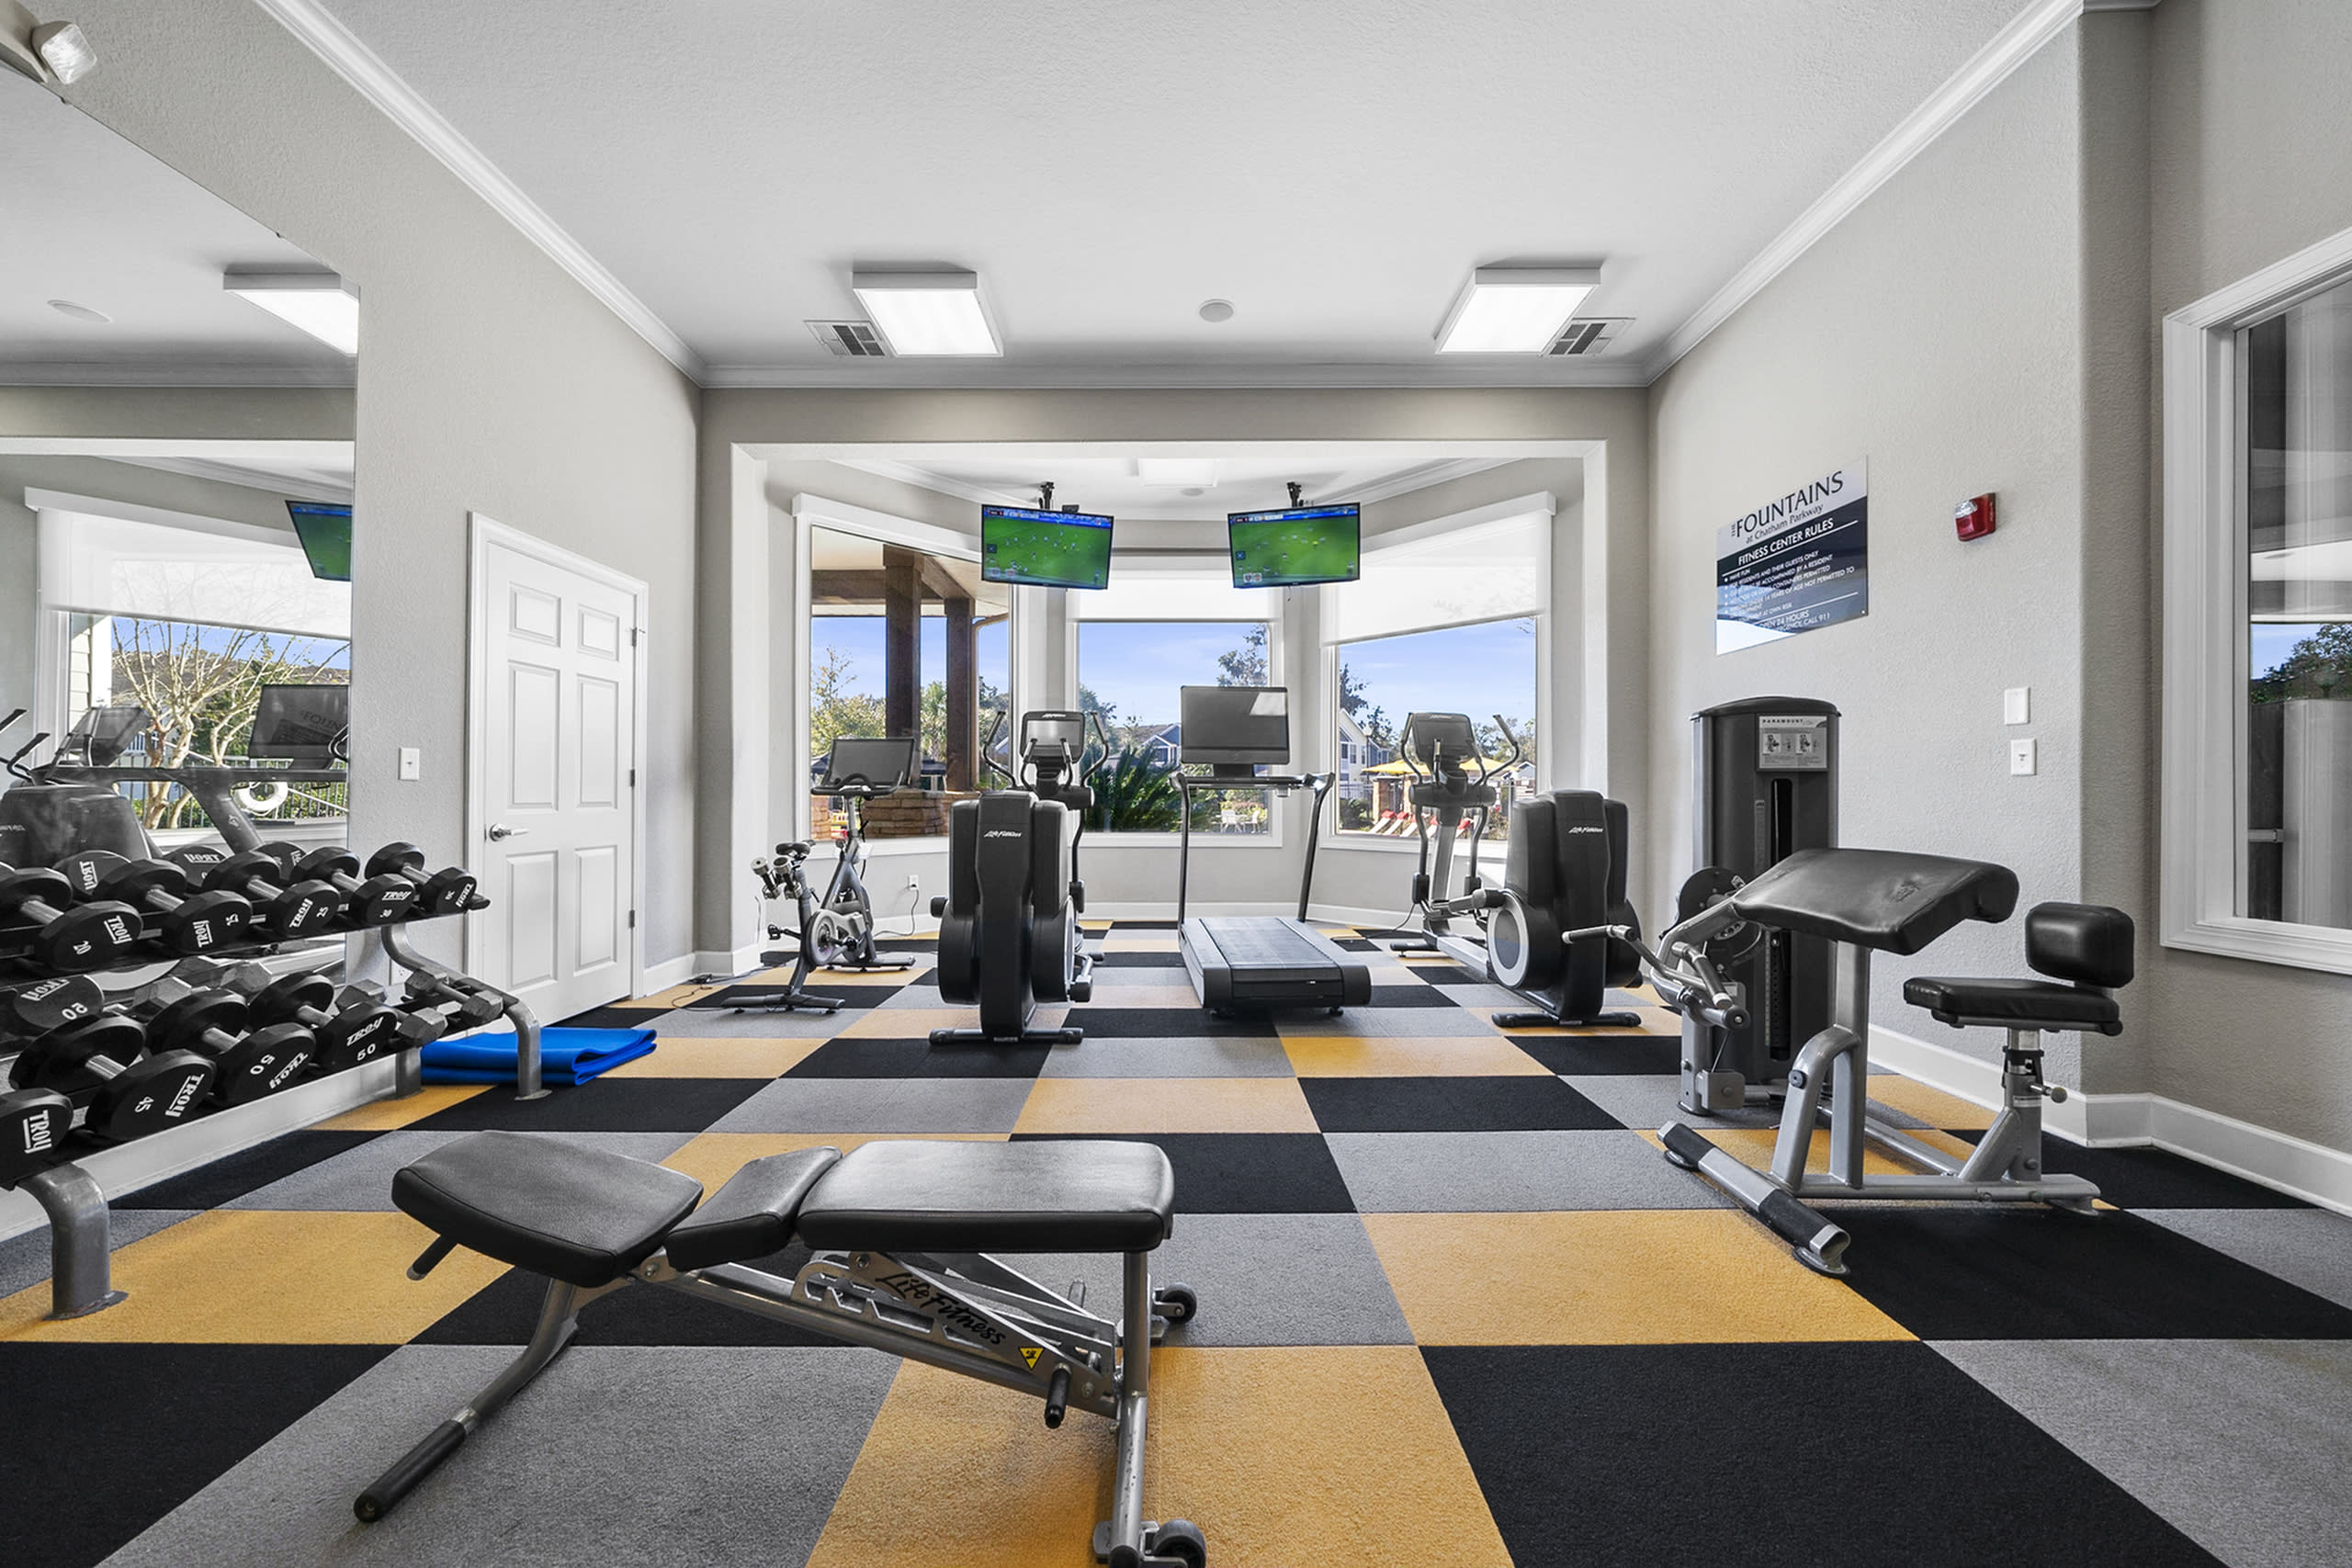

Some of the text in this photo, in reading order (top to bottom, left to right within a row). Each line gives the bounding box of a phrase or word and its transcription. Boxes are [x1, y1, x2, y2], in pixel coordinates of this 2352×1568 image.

[1736, 470, 1843, 537] FOUNTAINS
[1746, 501, 1823, 544] at Chatham Parkway
[1738, 516, 1833, 566] FITNESS CENTER RULES
[1760, 567, 1770, 576] AND
[1771, 563, 1783, 572] THEIR
[1784, 555, 1803, 568] GUESTS
[1804, 549, 1818, 560] ONLY
[1762, 567, 1795, 585] ACCOMPANIED
[1796, 564, 1803, 572] BY
[1808, 553, 1832, 569] RESIDENT
[1804, 563, 1830, 579] PERMITTED
[1784, 586, 1792, 594] OF
[1792, 582, 1803, 592] AGE
[1804, 579, 1815, 588] NOT
[1816, 569, 1844, 583] PERMITTED
[1846, 565, 1854, 574] TO
[1776, 616, 1784, 626] 24
[1786, 609, 1809, 623] HOURS
[1804, 615, 1816, 626] CALL
[1819, 611, 1829, 621] 911
[381, 891, 412, 901] TROY
[288, 898, 313, 928] TROY
[316, 906, 329, 918] 25
[104, 915, 132, 944] TROY
[193, 919, 213, 948] TROY
[73, 940, 92, 955] 20
[345, 1015, 384, 1047] TROY
[250, 1054, 276, 1076] 50
[356, 1043, 376, 1061] 50
[268, 1052, 309, 1089] TROY
[134, 1096, 154, 1113] 45
[164, 1073, 205, 1118] TROY
[23, 1109, 52, 1155] TROY
[875, 1271, 1007, 1346] Life Fitness
